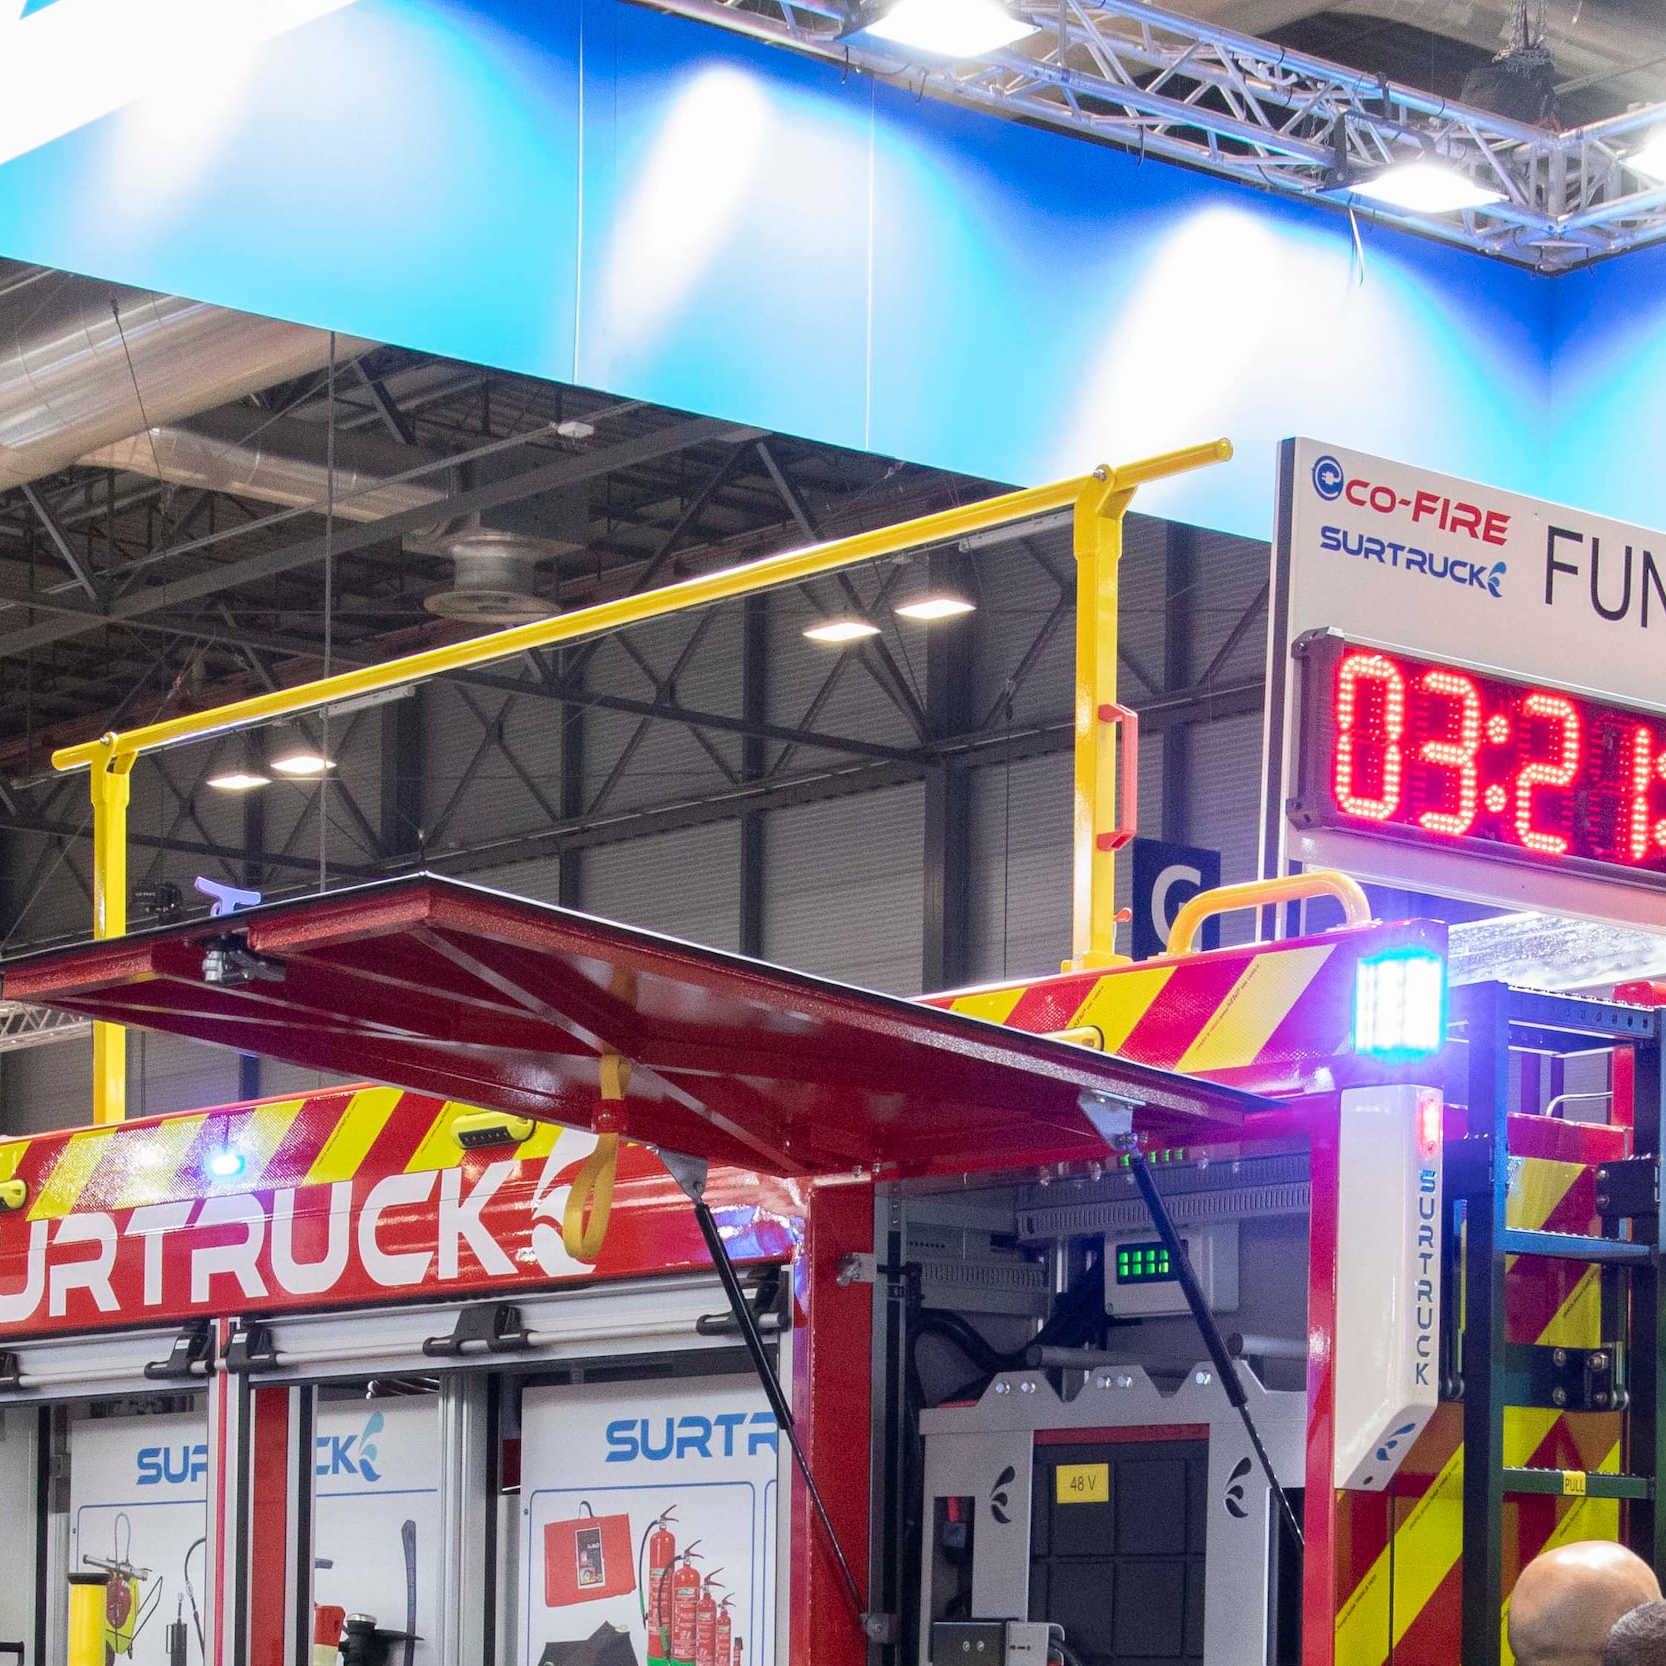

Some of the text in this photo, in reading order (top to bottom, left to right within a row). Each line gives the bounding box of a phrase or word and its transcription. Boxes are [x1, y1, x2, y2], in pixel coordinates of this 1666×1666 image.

[1320, 526, 1487, 590] SURTRUCK
[1416, 1170, 1437, 1386] SURTRUCK
[1070, 1474, 1096, 1492] 48 V
[1564, 1476, 1585, 1493] PULL
